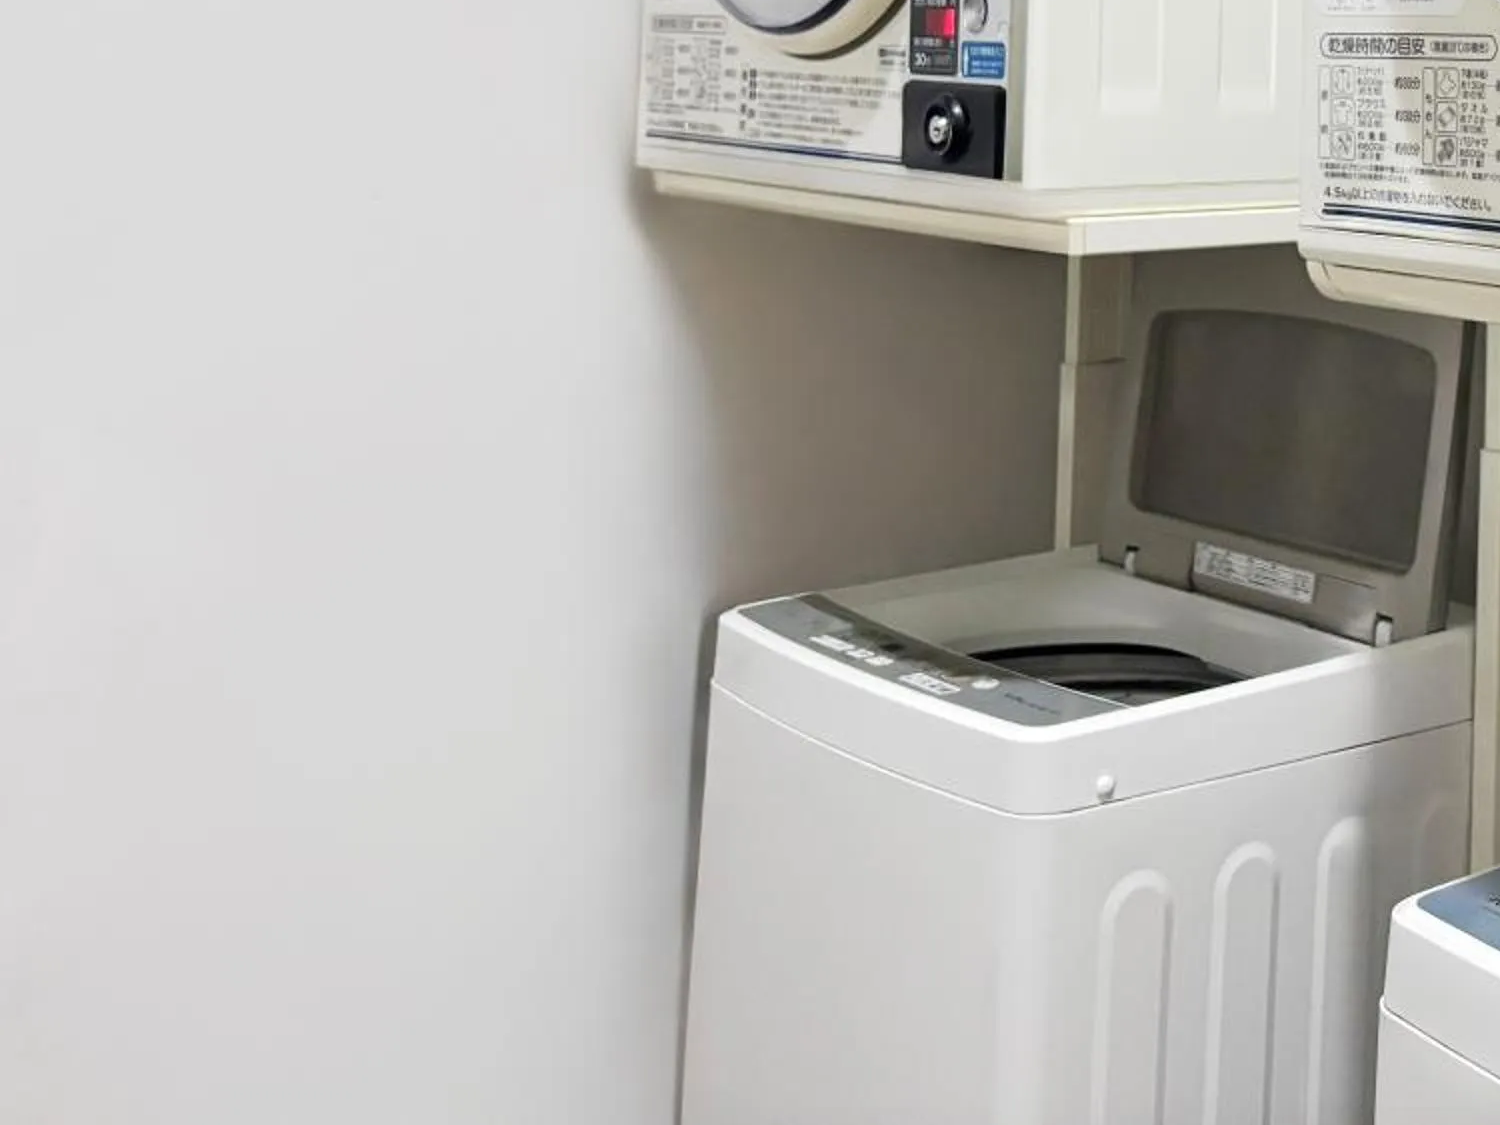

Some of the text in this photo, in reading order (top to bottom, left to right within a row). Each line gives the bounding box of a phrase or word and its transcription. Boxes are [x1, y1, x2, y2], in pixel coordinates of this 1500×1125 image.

[1328, 37, 1426, 56] 乾燥時間の目安
